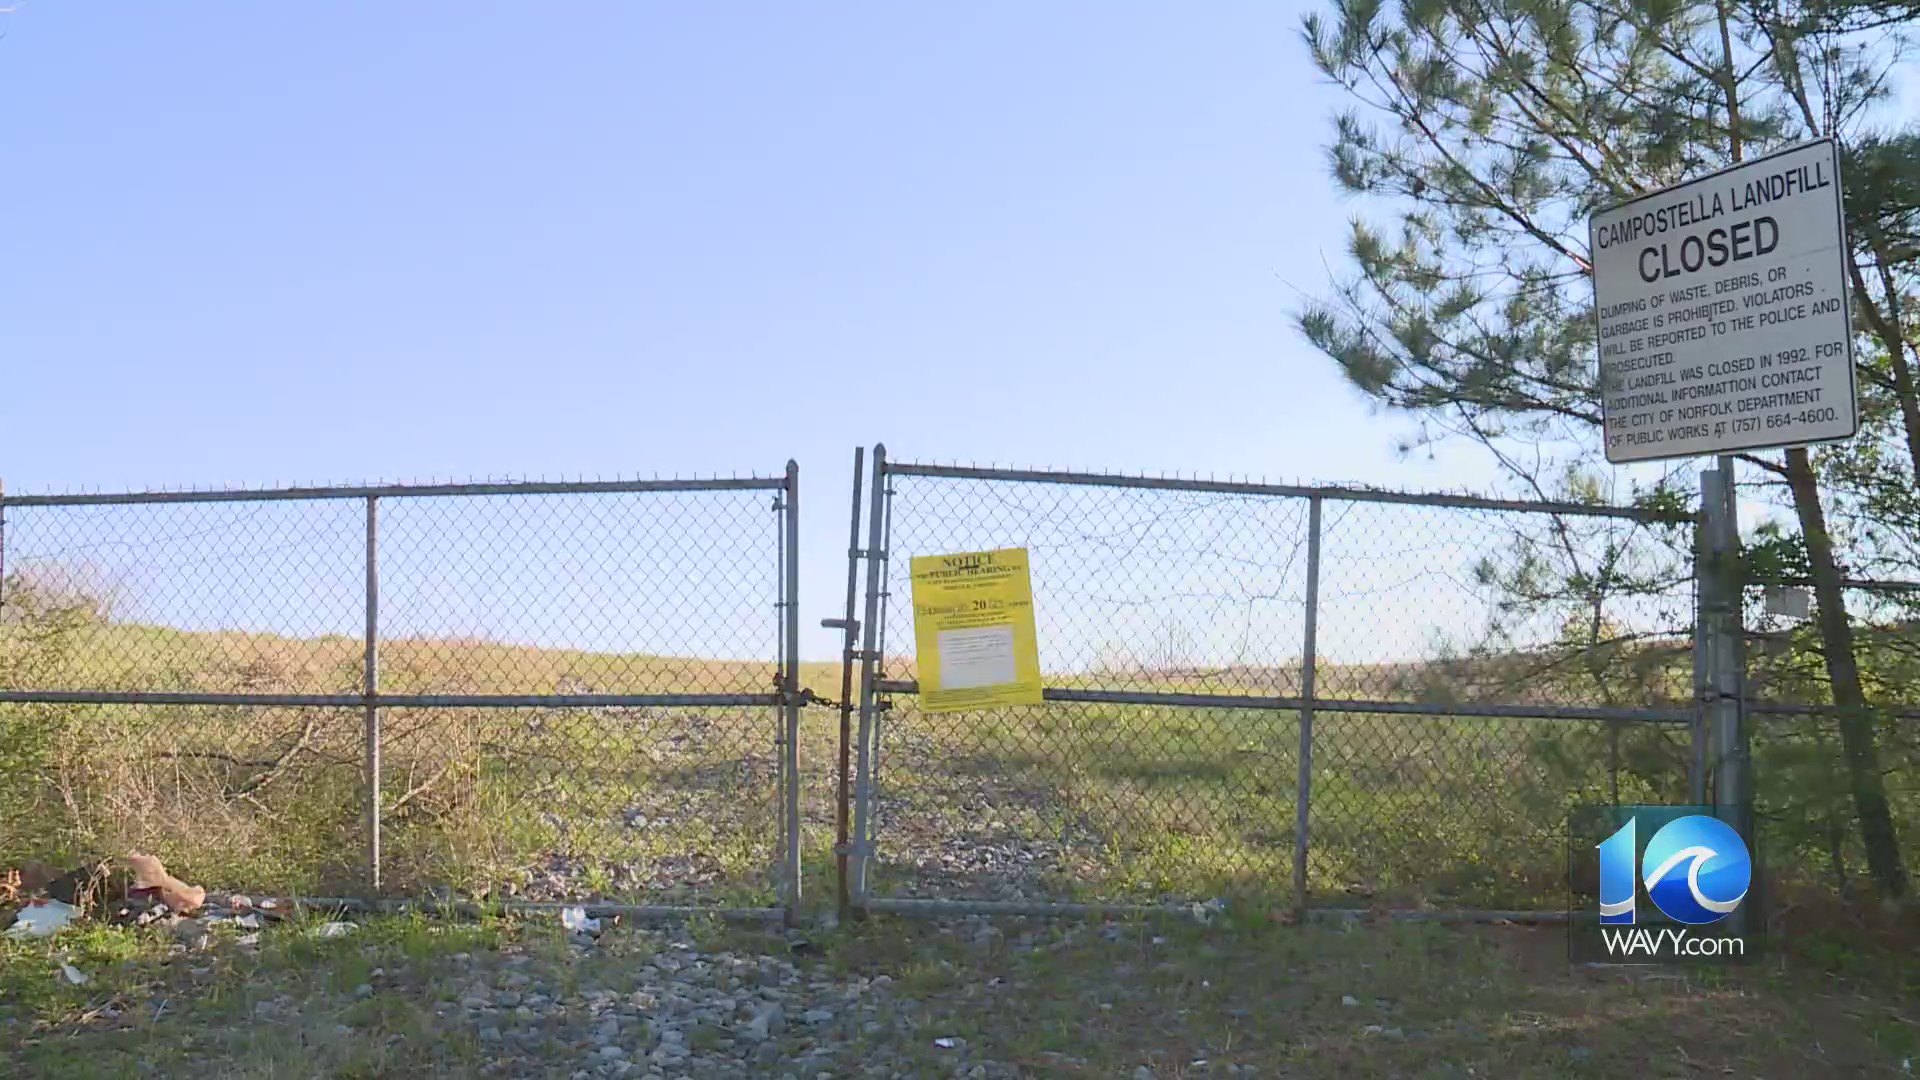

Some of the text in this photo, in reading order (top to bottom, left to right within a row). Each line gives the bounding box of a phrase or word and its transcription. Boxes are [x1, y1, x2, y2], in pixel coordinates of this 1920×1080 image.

[1598, 161, 1830, 249] CAMPOSTELLA LANDFILL
[1638, 216, 1779, 283] CLOSED
[1600, 298, 1647, 319] DUMPING
[1650, 294, 1665, 309] OF
[1715, 272, 1763, 294] DEBRIS,
[1768, 266, 1787, 283] OR
[1601, 318, 1649, 339] GARBAGE
[1653, 314, 1664, 328] IS
[1742, 281, 1814, 309] VIOLATORS
[1602, 297, 1841, 357] WILL BE REPORTED TO THE POLICE AND
[1607, 391, 1668, 411] ADDITIONAL
[1761, 365, 1823, 389] CONTACT
[1627, 371, 1677, 390] LANDFILL
[1680, 366, 1704, 382] WAS
[1707, 357, 1755, 377] CLOSED
[1760, 353, 1772, 369] IN
[1775, 347, 1810, 365] 1992.
[1815, 341, 1843, 359] FOR
[1609, 388, 1823, 430] THE CITY OF NORFOLK DEPARTMENT
[1609, 407, 1839, 448] OF PUBLIC WORKS AT (757) 664-4600.
[972, 600, 987, 611] 20
